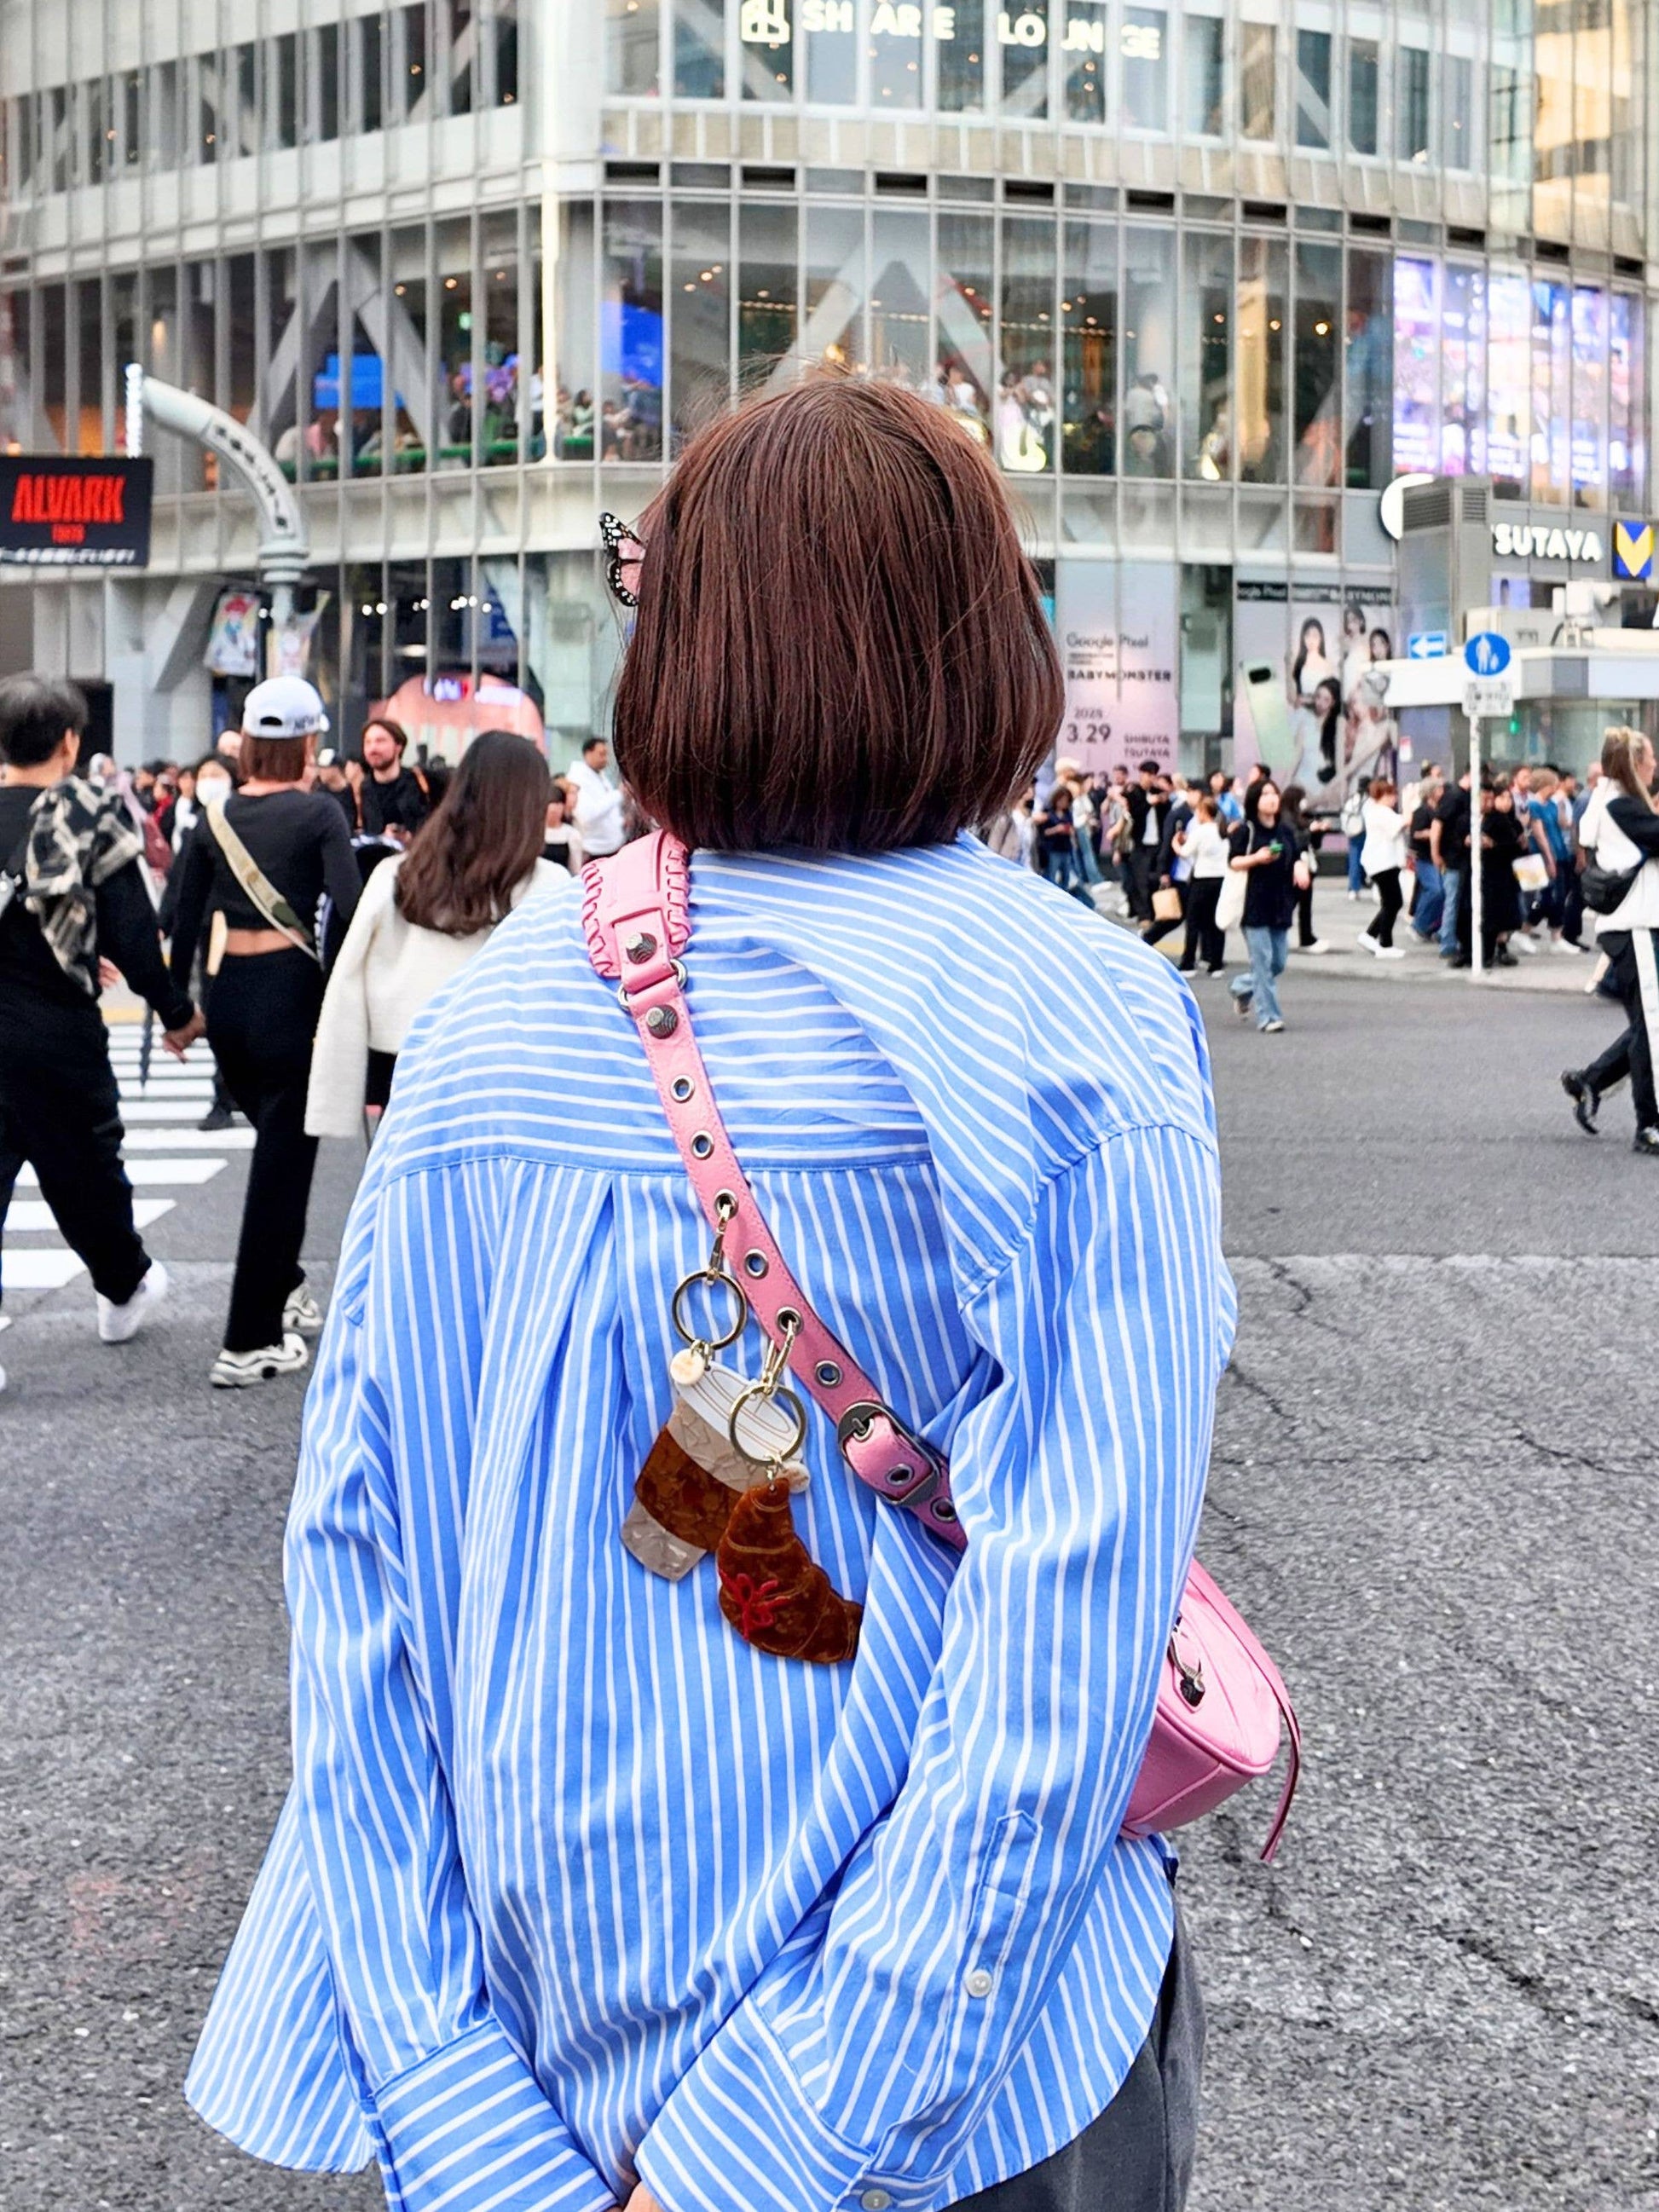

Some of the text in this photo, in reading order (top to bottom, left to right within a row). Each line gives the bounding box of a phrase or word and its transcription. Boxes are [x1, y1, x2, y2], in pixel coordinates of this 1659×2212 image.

[801, 0, 956, 40] SHARE
[11, 474, 125, 523] ALVARK
[1491, 523, 1602, 563] SUTAYA
[1066, 632, 1149, 649] Google Pixel
[1066, 723, 1112, 744] 3.29
[1124, 734, 1170, 745] SHIBUYA
[1124, 748, 1171, 759] TSUTAYA
